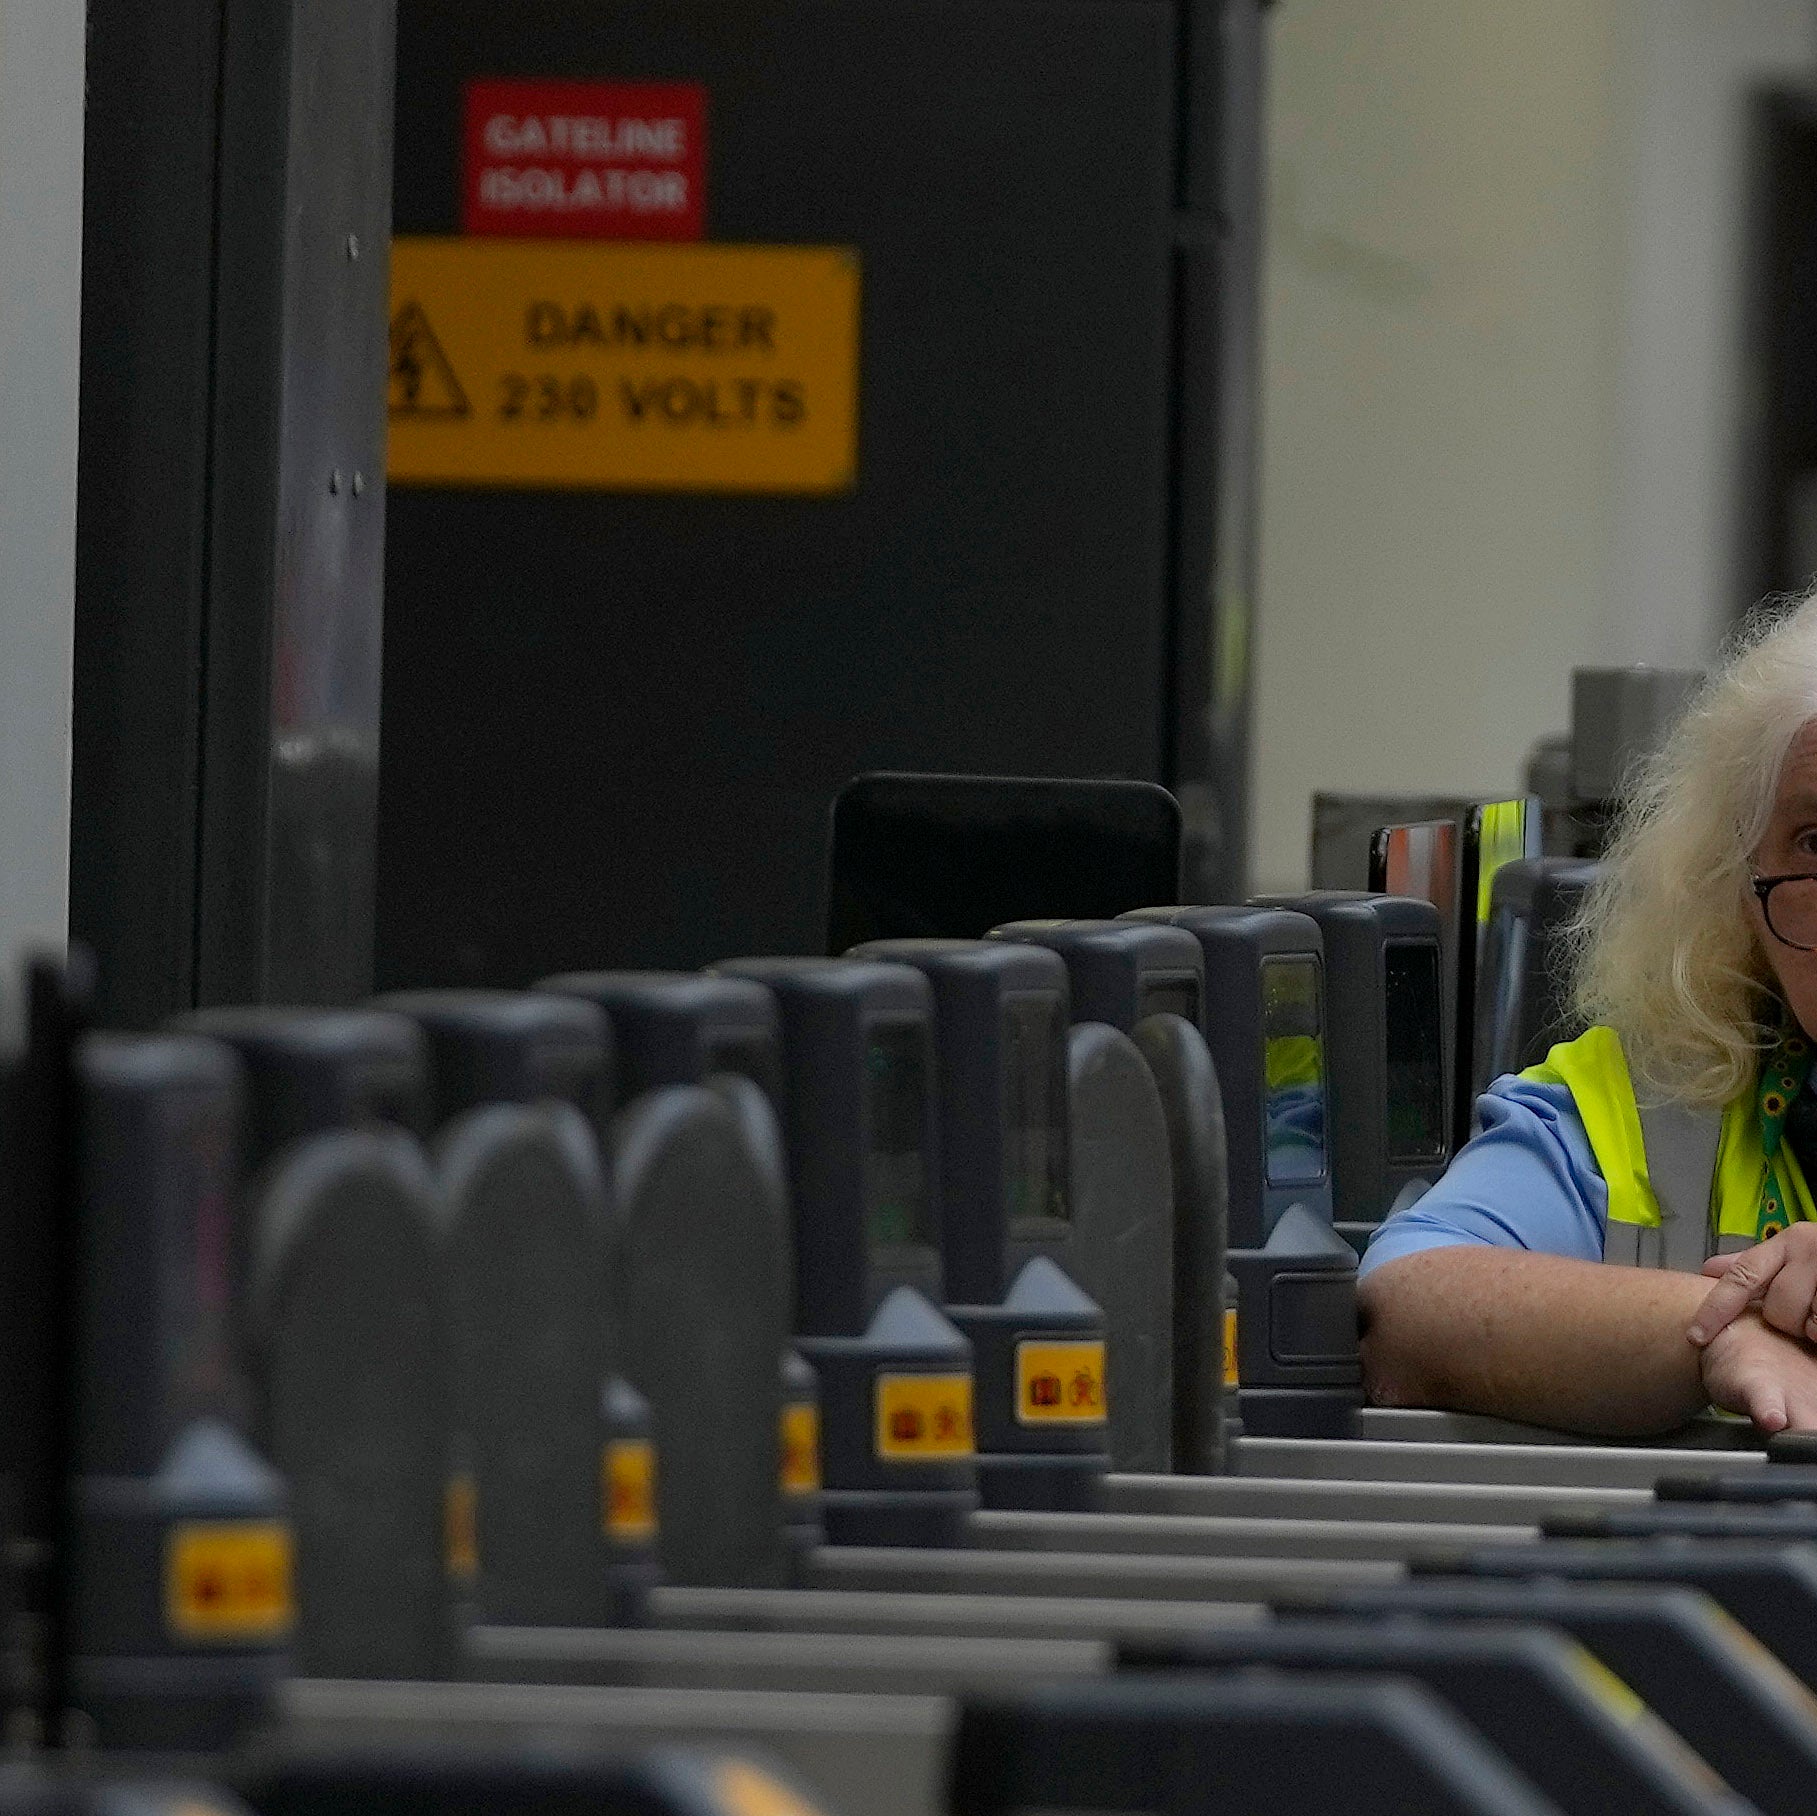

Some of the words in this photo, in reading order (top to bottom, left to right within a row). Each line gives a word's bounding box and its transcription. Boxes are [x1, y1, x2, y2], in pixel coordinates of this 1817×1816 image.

[483, 115, 686, 158] GATELINE
[480, 167, 688, 210] ISOLATOR
[524, 301, 776, 350] DANGER
[500, 372, 598, 426] 230
[616, 375, 807, 430] VOLTS
